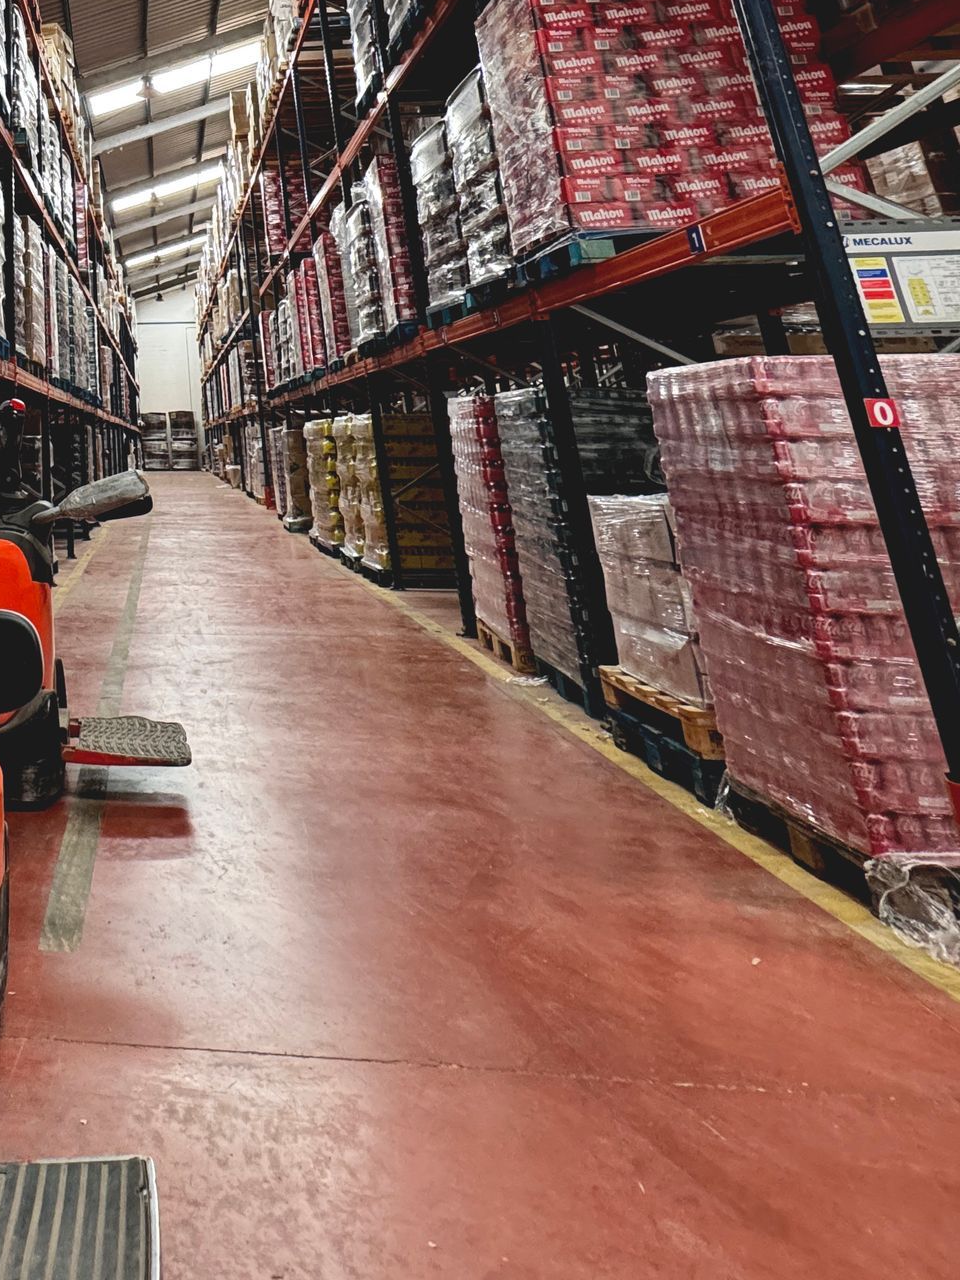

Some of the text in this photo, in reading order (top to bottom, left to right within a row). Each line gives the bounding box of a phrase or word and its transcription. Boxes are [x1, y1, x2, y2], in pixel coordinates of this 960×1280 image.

[704, 25, 740, 38] Maho
[717, 74, 753, 87] Maho
[809, 120, 842, 133] ahou
[742, 177, 780, 190] Maho
[691, 232, 699, 248] 1
[852, 236, 913, 246] MECALUX
[873, 401, 894, 426] 0
